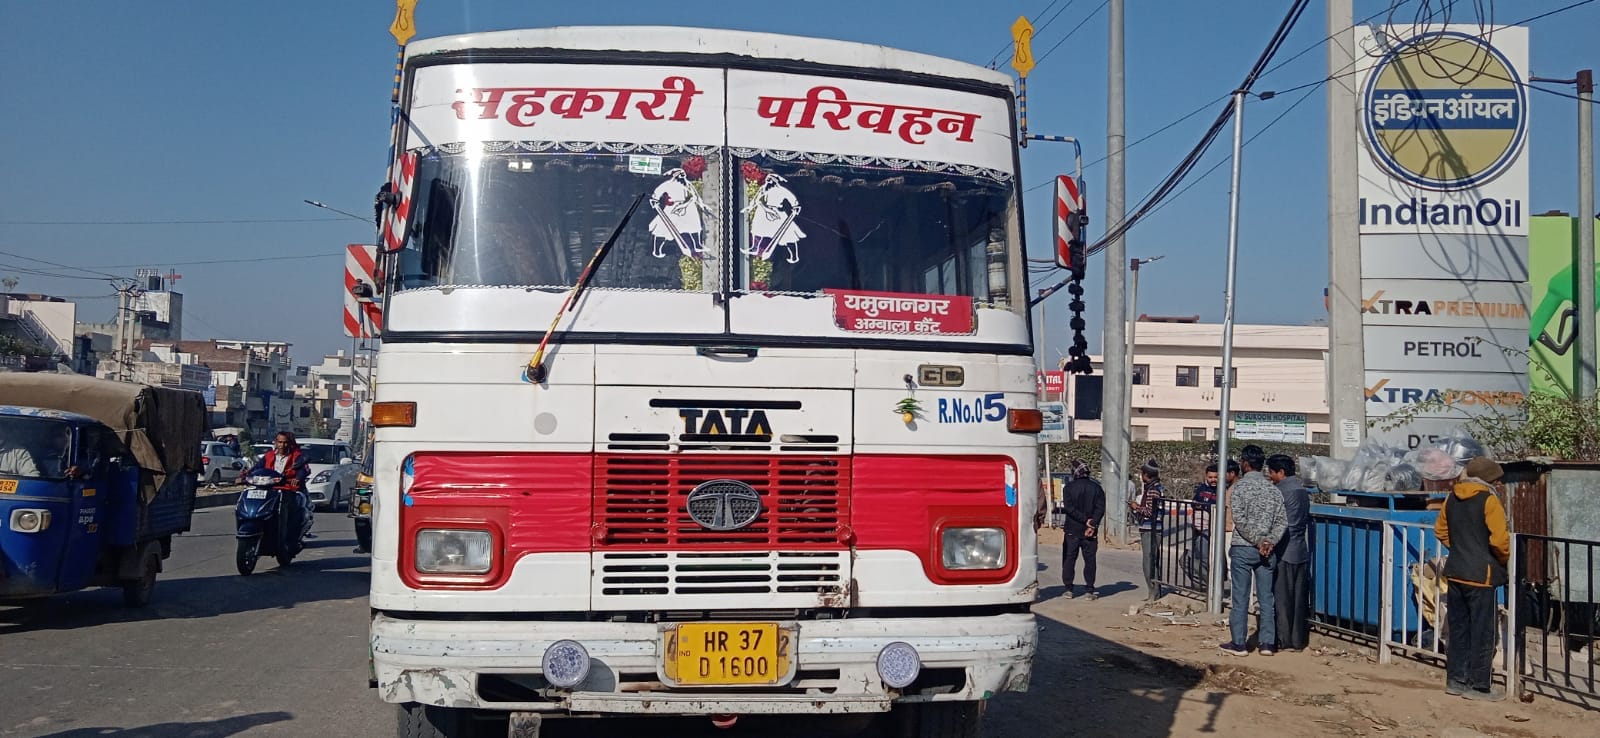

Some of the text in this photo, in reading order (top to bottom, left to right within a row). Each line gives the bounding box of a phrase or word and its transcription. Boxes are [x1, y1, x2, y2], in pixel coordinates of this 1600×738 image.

[757, 85, 982, 144] परिवहन
[1360, 198, 1521, 227] IndianOil
[844, 295, 950, 317] यमुनानगर
[1404, 341, 1482, 358] PETROL
[679, 409, 773, 434] TATA
[705, 631, 729, 652] HR
[740, 630, 763, 651] 37
[700, 656, 768, 677] D 1600
